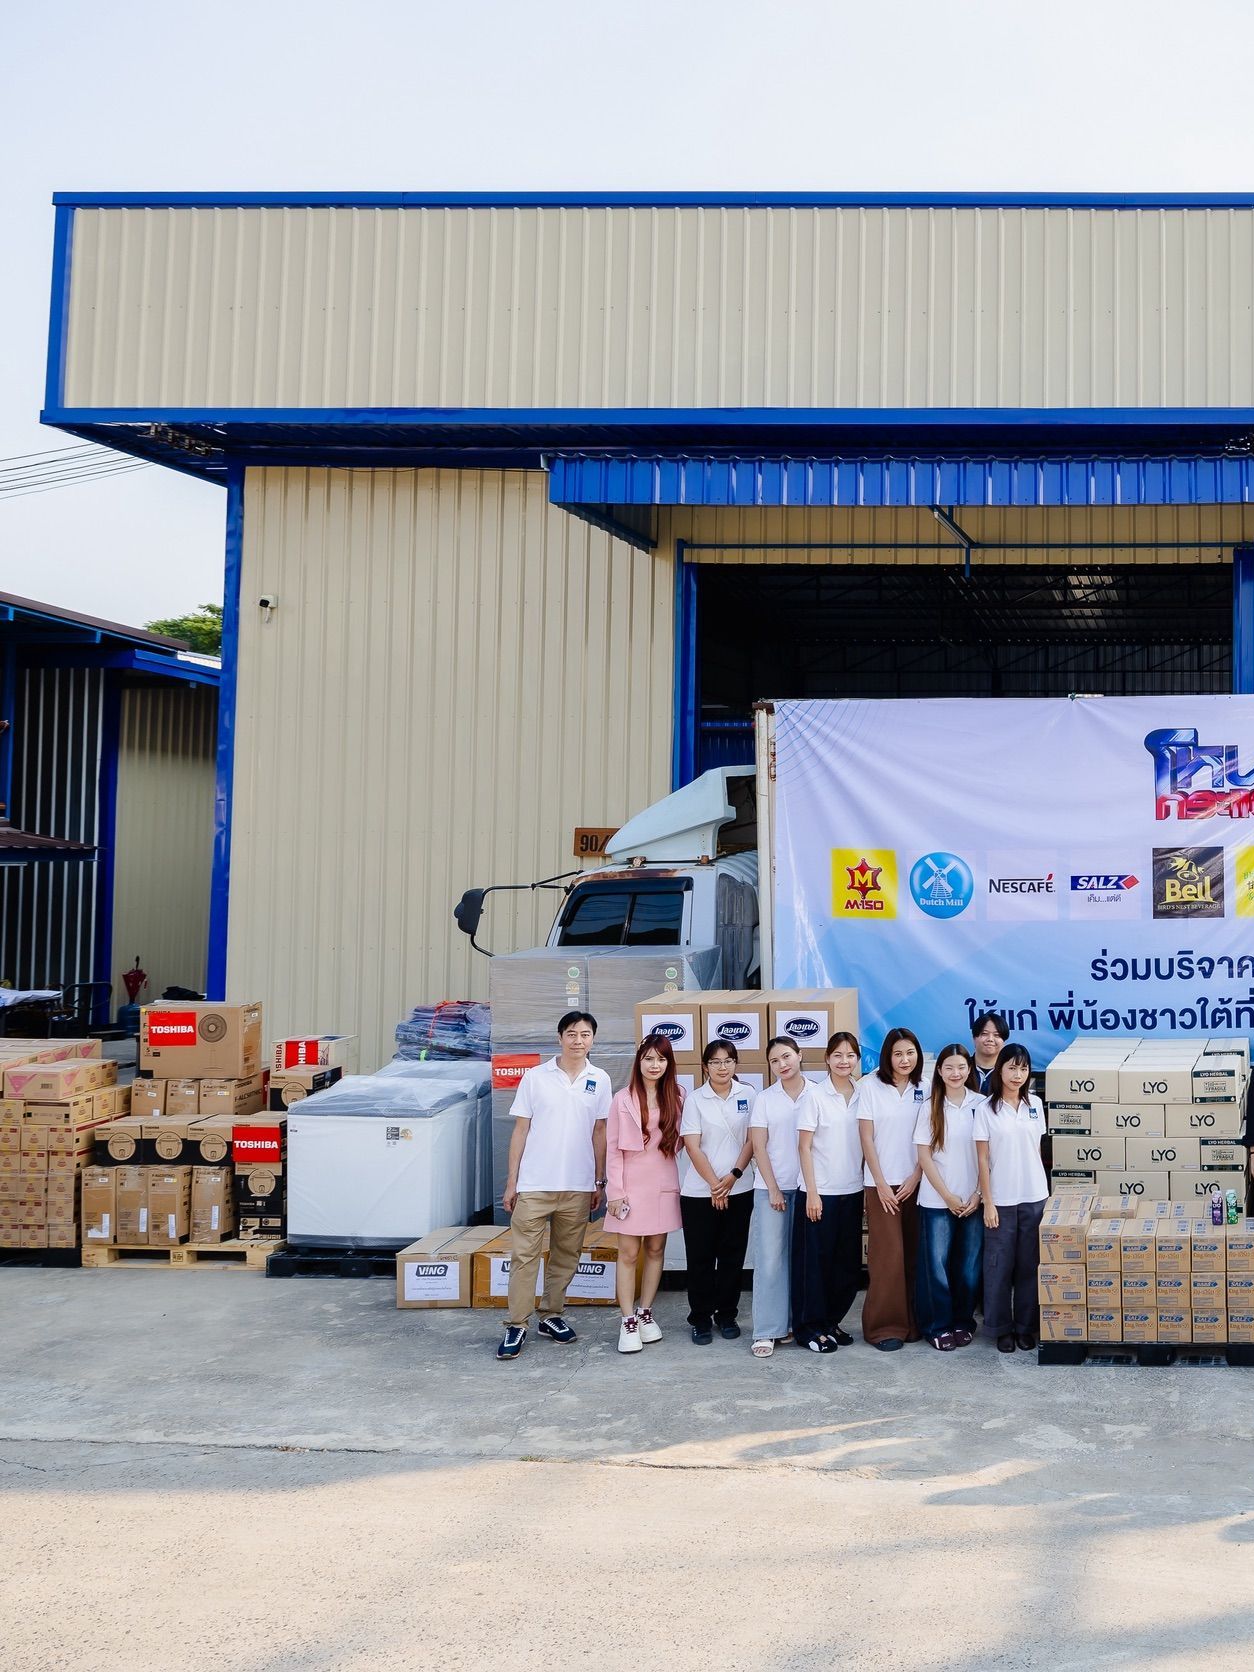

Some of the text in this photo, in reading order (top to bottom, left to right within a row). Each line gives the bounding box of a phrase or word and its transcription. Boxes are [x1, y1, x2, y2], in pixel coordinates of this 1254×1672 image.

[580, 834, 611, 852] 90/
[1076, 876, 1119, 890] SALZ
[1164, 876, 1214, 901] Bell
[919, 898, 964, 906] Dutch Mill
[150, 1026, 194, 1034] TOSHIBA
[298, 1042, 306, 1064] HIBA
[494, 1068, 529, 1076] TOSHI
[1070, 1080, 1095, 1092] LYO
[1142, 1082, 1168, 1094] LYO
[1116, 1115, 1140, 1128] LYO
[1190, 1114, 1216, 1127] LYO
[234, 1140, 279, 1149] TOSHIBA
[1077, 1148, 1102, 1161] LYO
[1151, 1149, 1176, 1162] LYO
[1120, 1182, 1144, 1195] LYO
[1195, 1182, 1220, 1195] LYO
